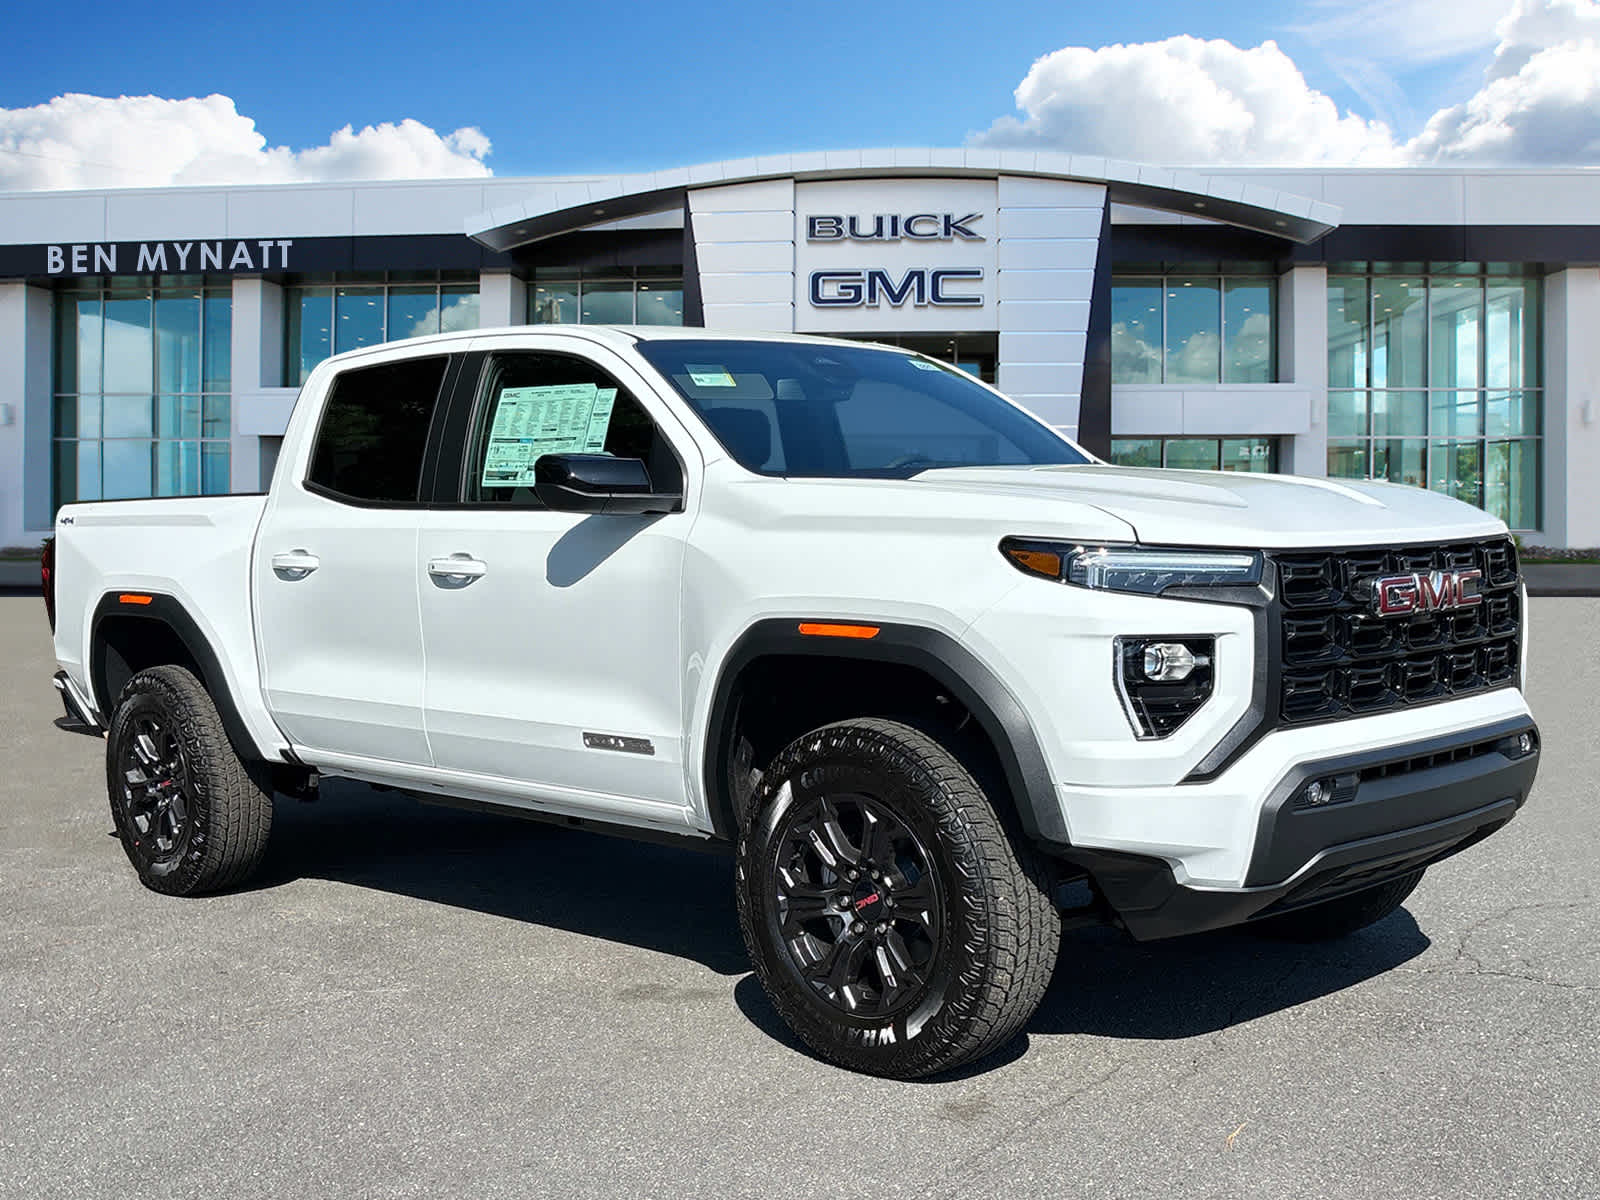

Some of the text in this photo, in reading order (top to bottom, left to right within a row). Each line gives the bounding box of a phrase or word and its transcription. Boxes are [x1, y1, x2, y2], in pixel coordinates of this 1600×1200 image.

[806, 213, 986, 241] BUICK
[47, 240, 293, 274] BEN MYNATT
[808, 267, 985, 308] GMC
[1376, 569, 1482, 617] GMC
